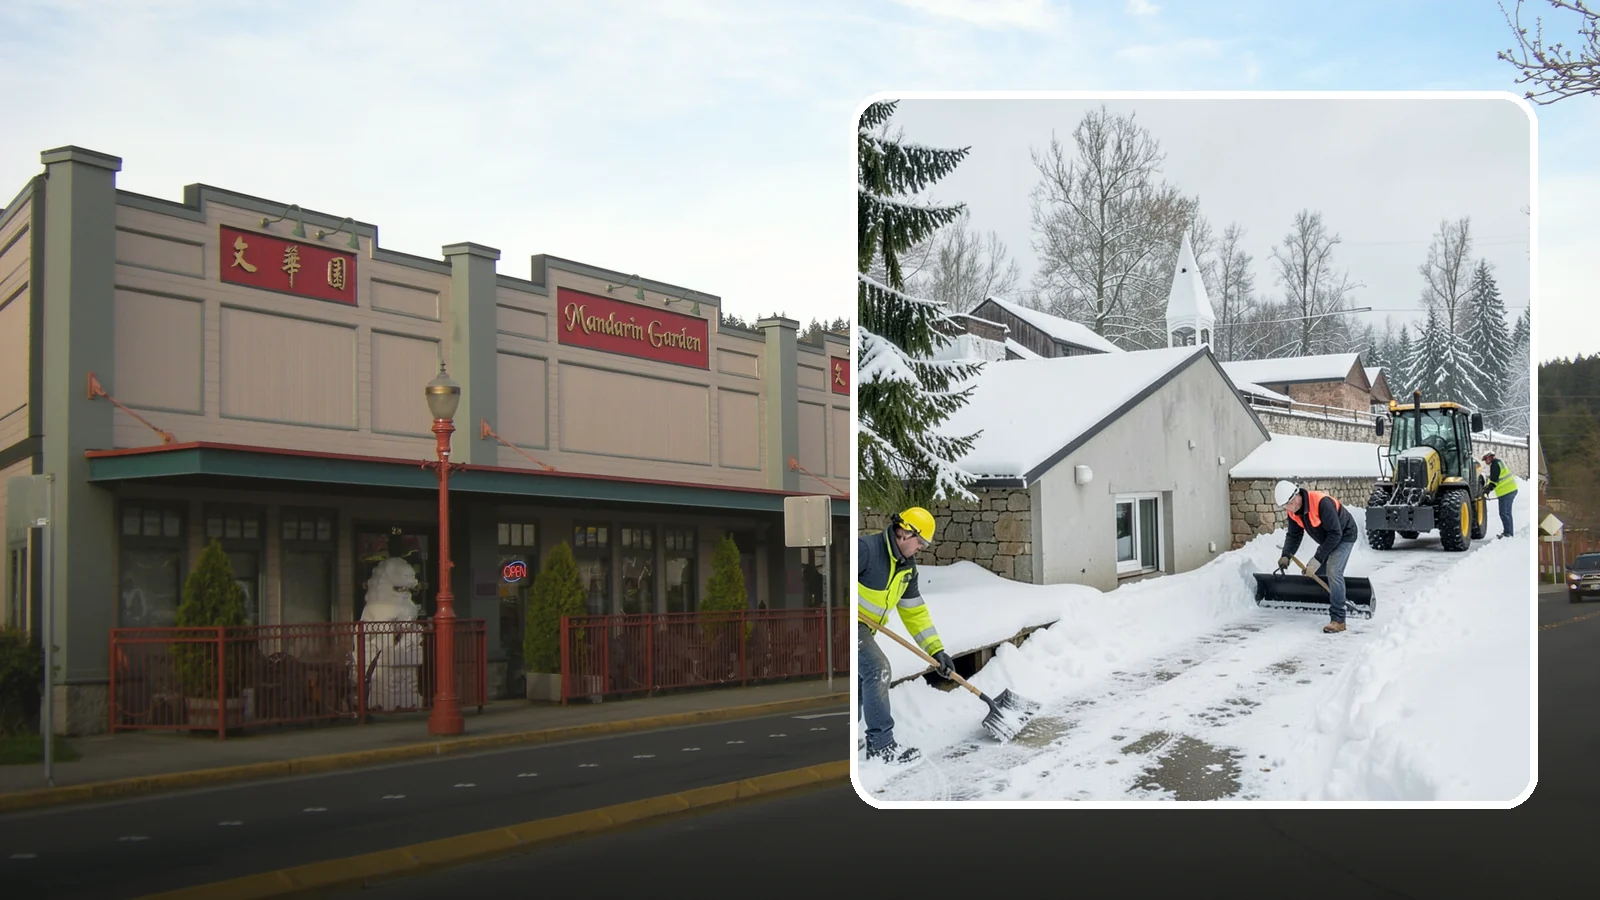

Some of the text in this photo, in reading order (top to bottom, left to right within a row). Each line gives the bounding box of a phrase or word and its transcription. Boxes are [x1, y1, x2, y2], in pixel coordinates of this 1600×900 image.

[231, 236, 346, 291] 文華園
[565, 302, 701, 352] Mandarin Garden
[835, 363, 847, 386] 文
[503, 565, 527, 578] OPEN
